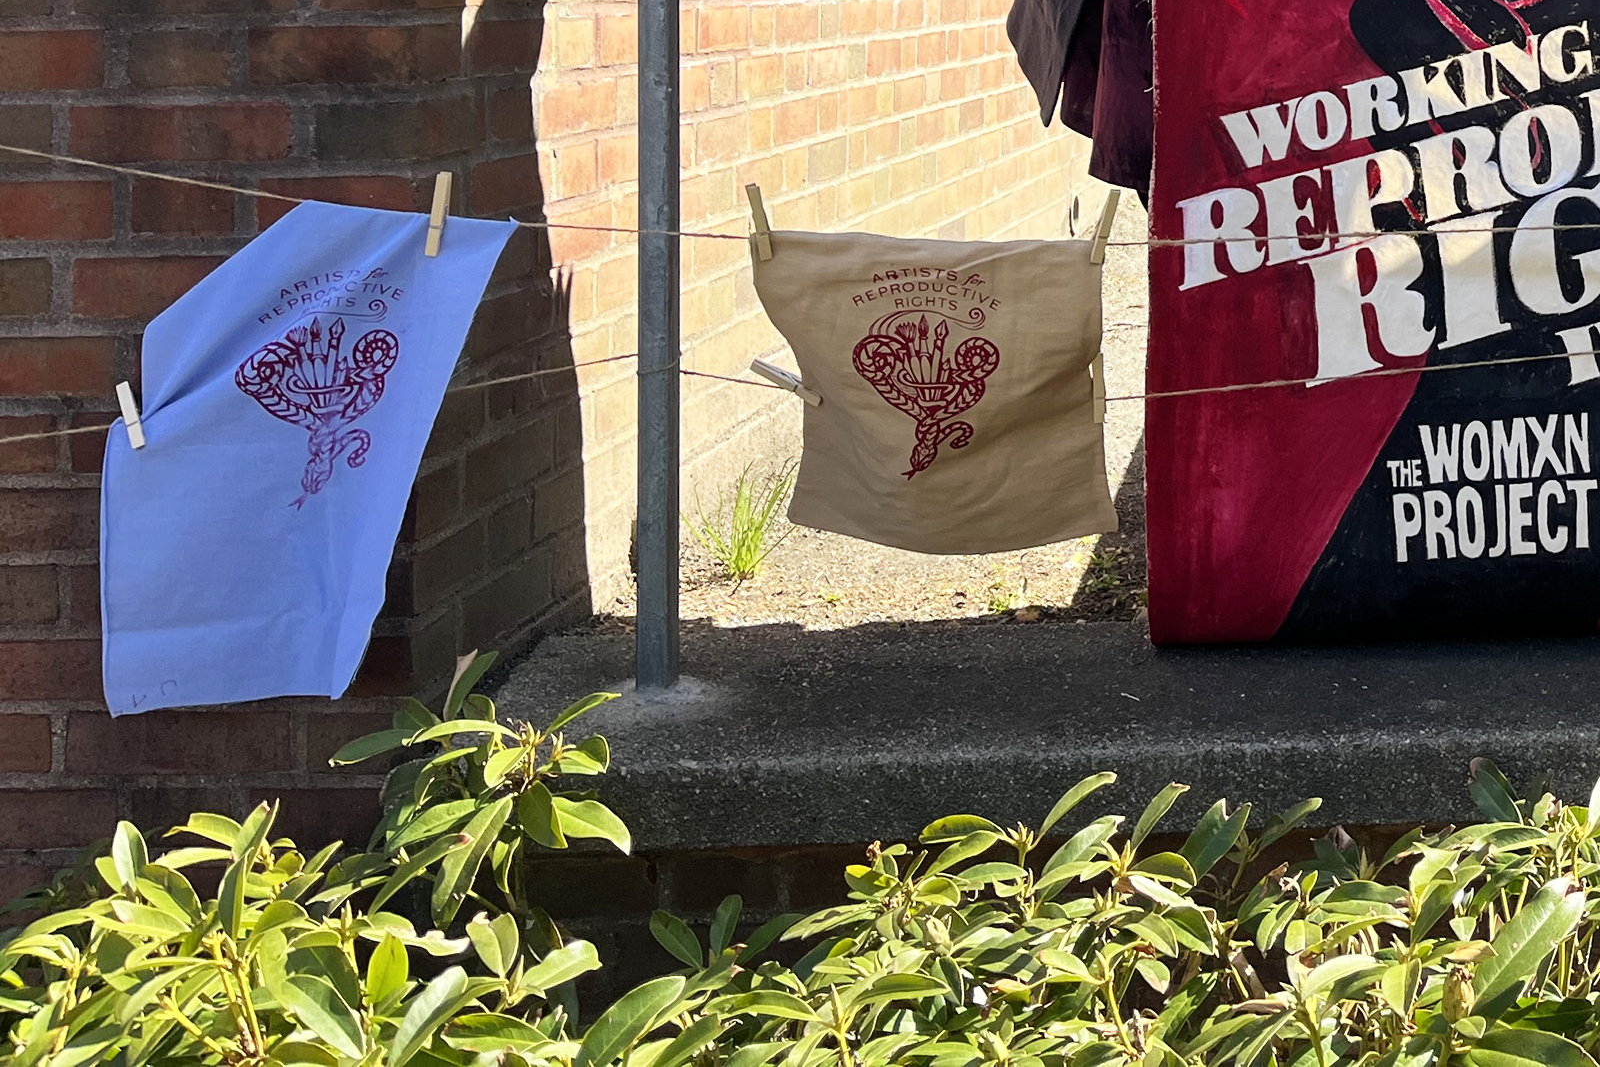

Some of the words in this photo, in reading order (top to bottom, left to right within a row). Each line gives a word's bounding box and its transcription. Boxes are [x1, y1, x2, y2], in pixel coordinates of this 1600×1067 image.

[1220, 20, 1594, 168] WORKING
[362, 267, 388, 281] for
[872, 267, 958, 284] ARTISTS
[962, 273, 986, 287] for
[852, 281, 1001, 311] REPRODUCTIVE
[895, 296, 958, 311] RIGHTS
[1387, 458, 1423, 487] THE
[1418, 412, 1591, 484] WOMXN
[1392, 479, 1598, 562] PROJECT
